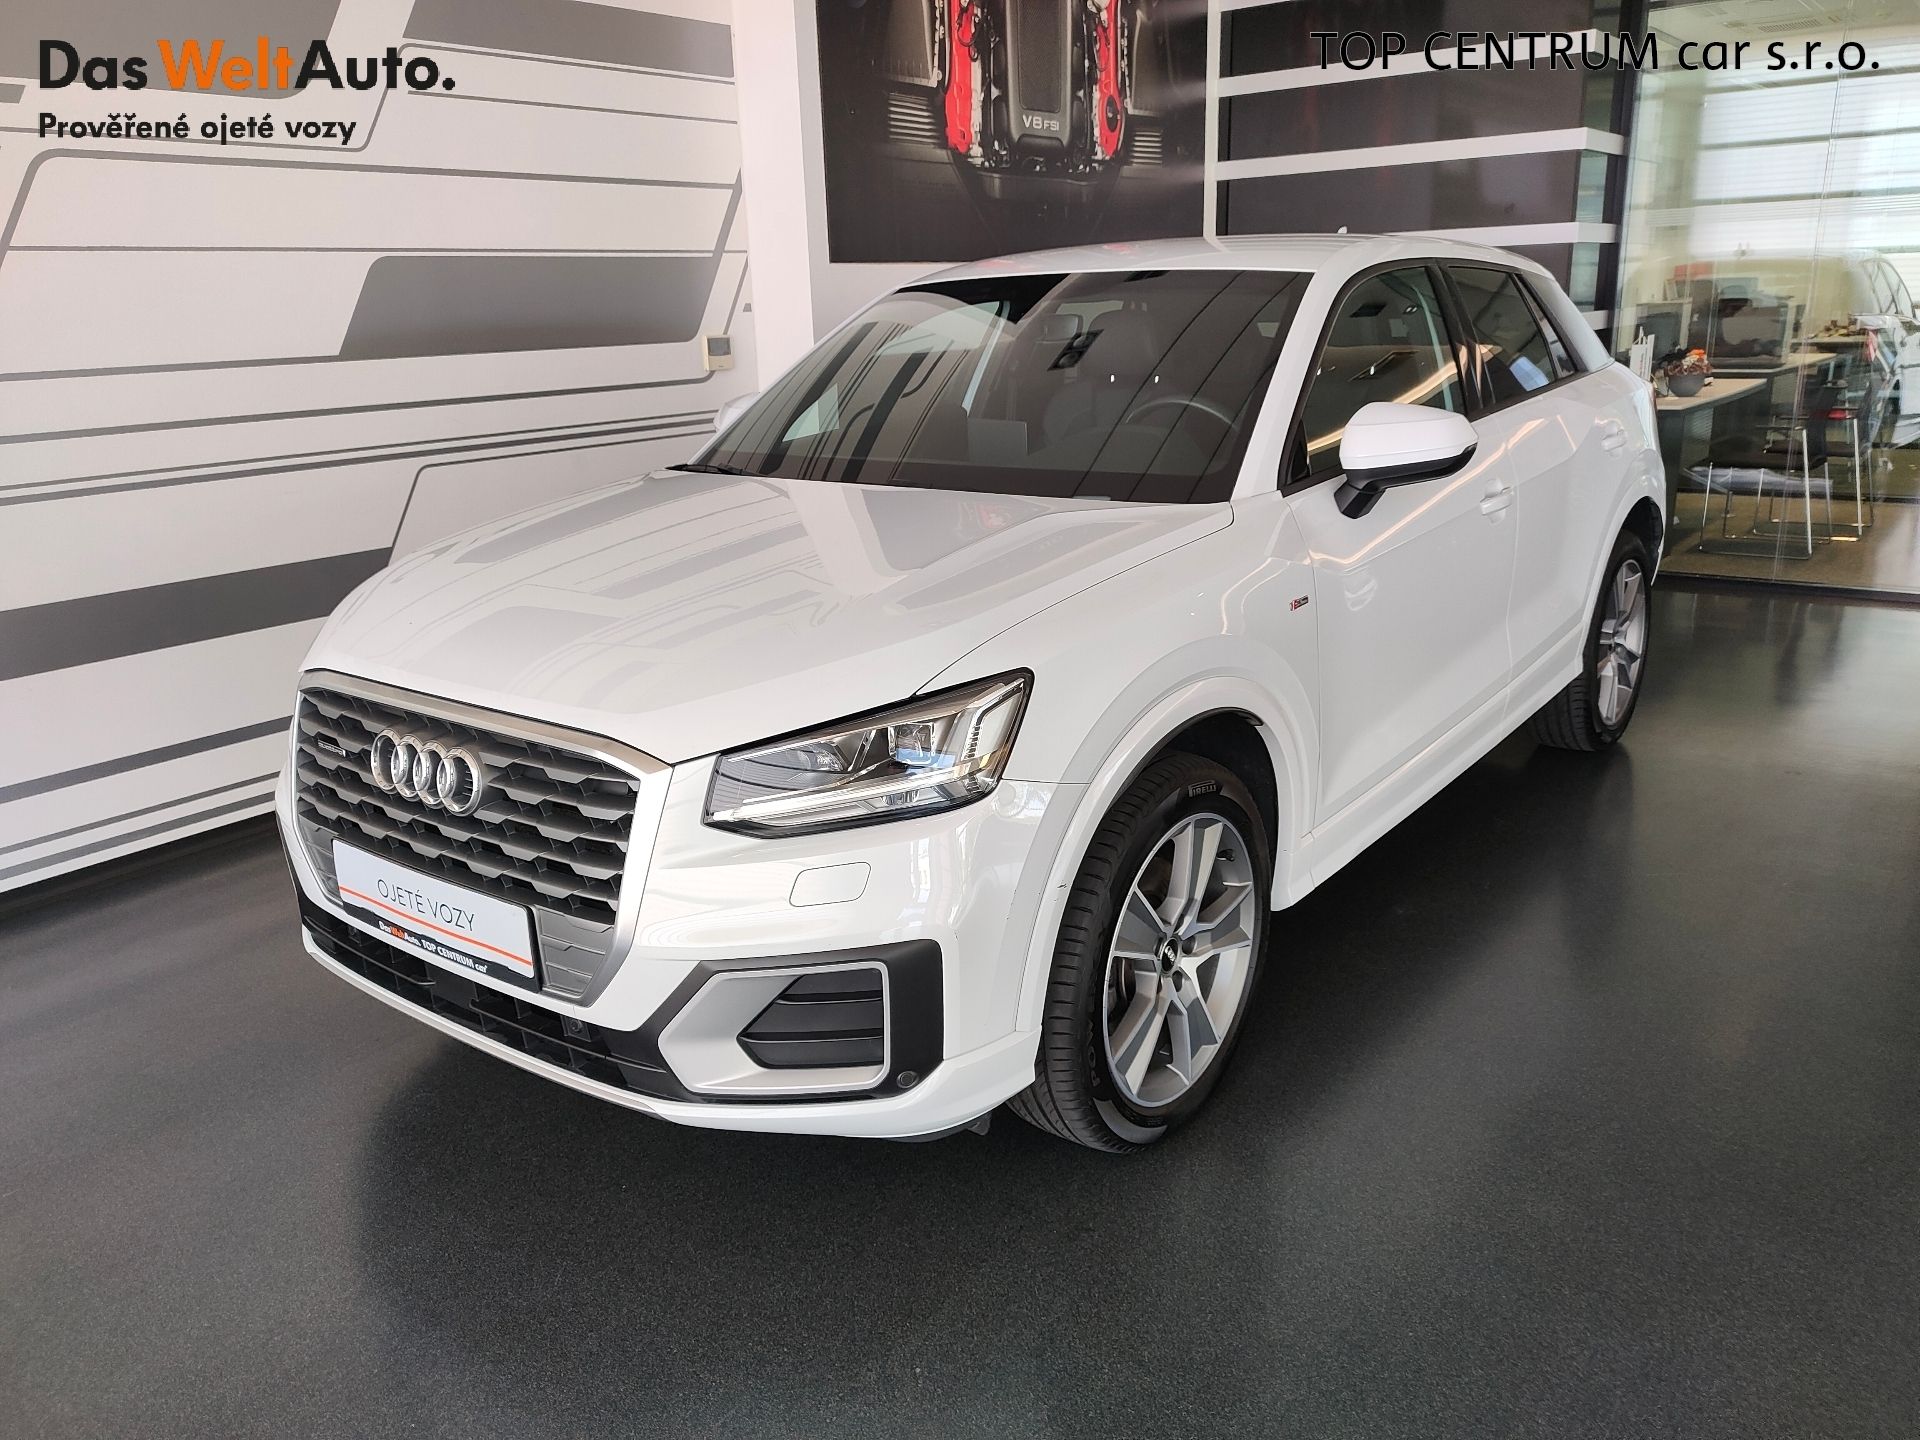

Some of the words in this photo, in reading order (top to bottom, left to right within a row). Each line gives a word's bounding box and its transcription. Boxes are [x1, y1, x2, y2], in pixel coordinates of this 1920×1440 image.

[1022, 114, 1042, 129] V8
[1043, 119, 1060, 131] FSI
[1187, 780, 1217, 798] PIRELLI
[377, 879, 425, 914] OJETÉ
[427, 898, 475, 932] VOZY
[421, 939, 437, 952] TOP
[437, 946, 475, 969] CENTRUM
